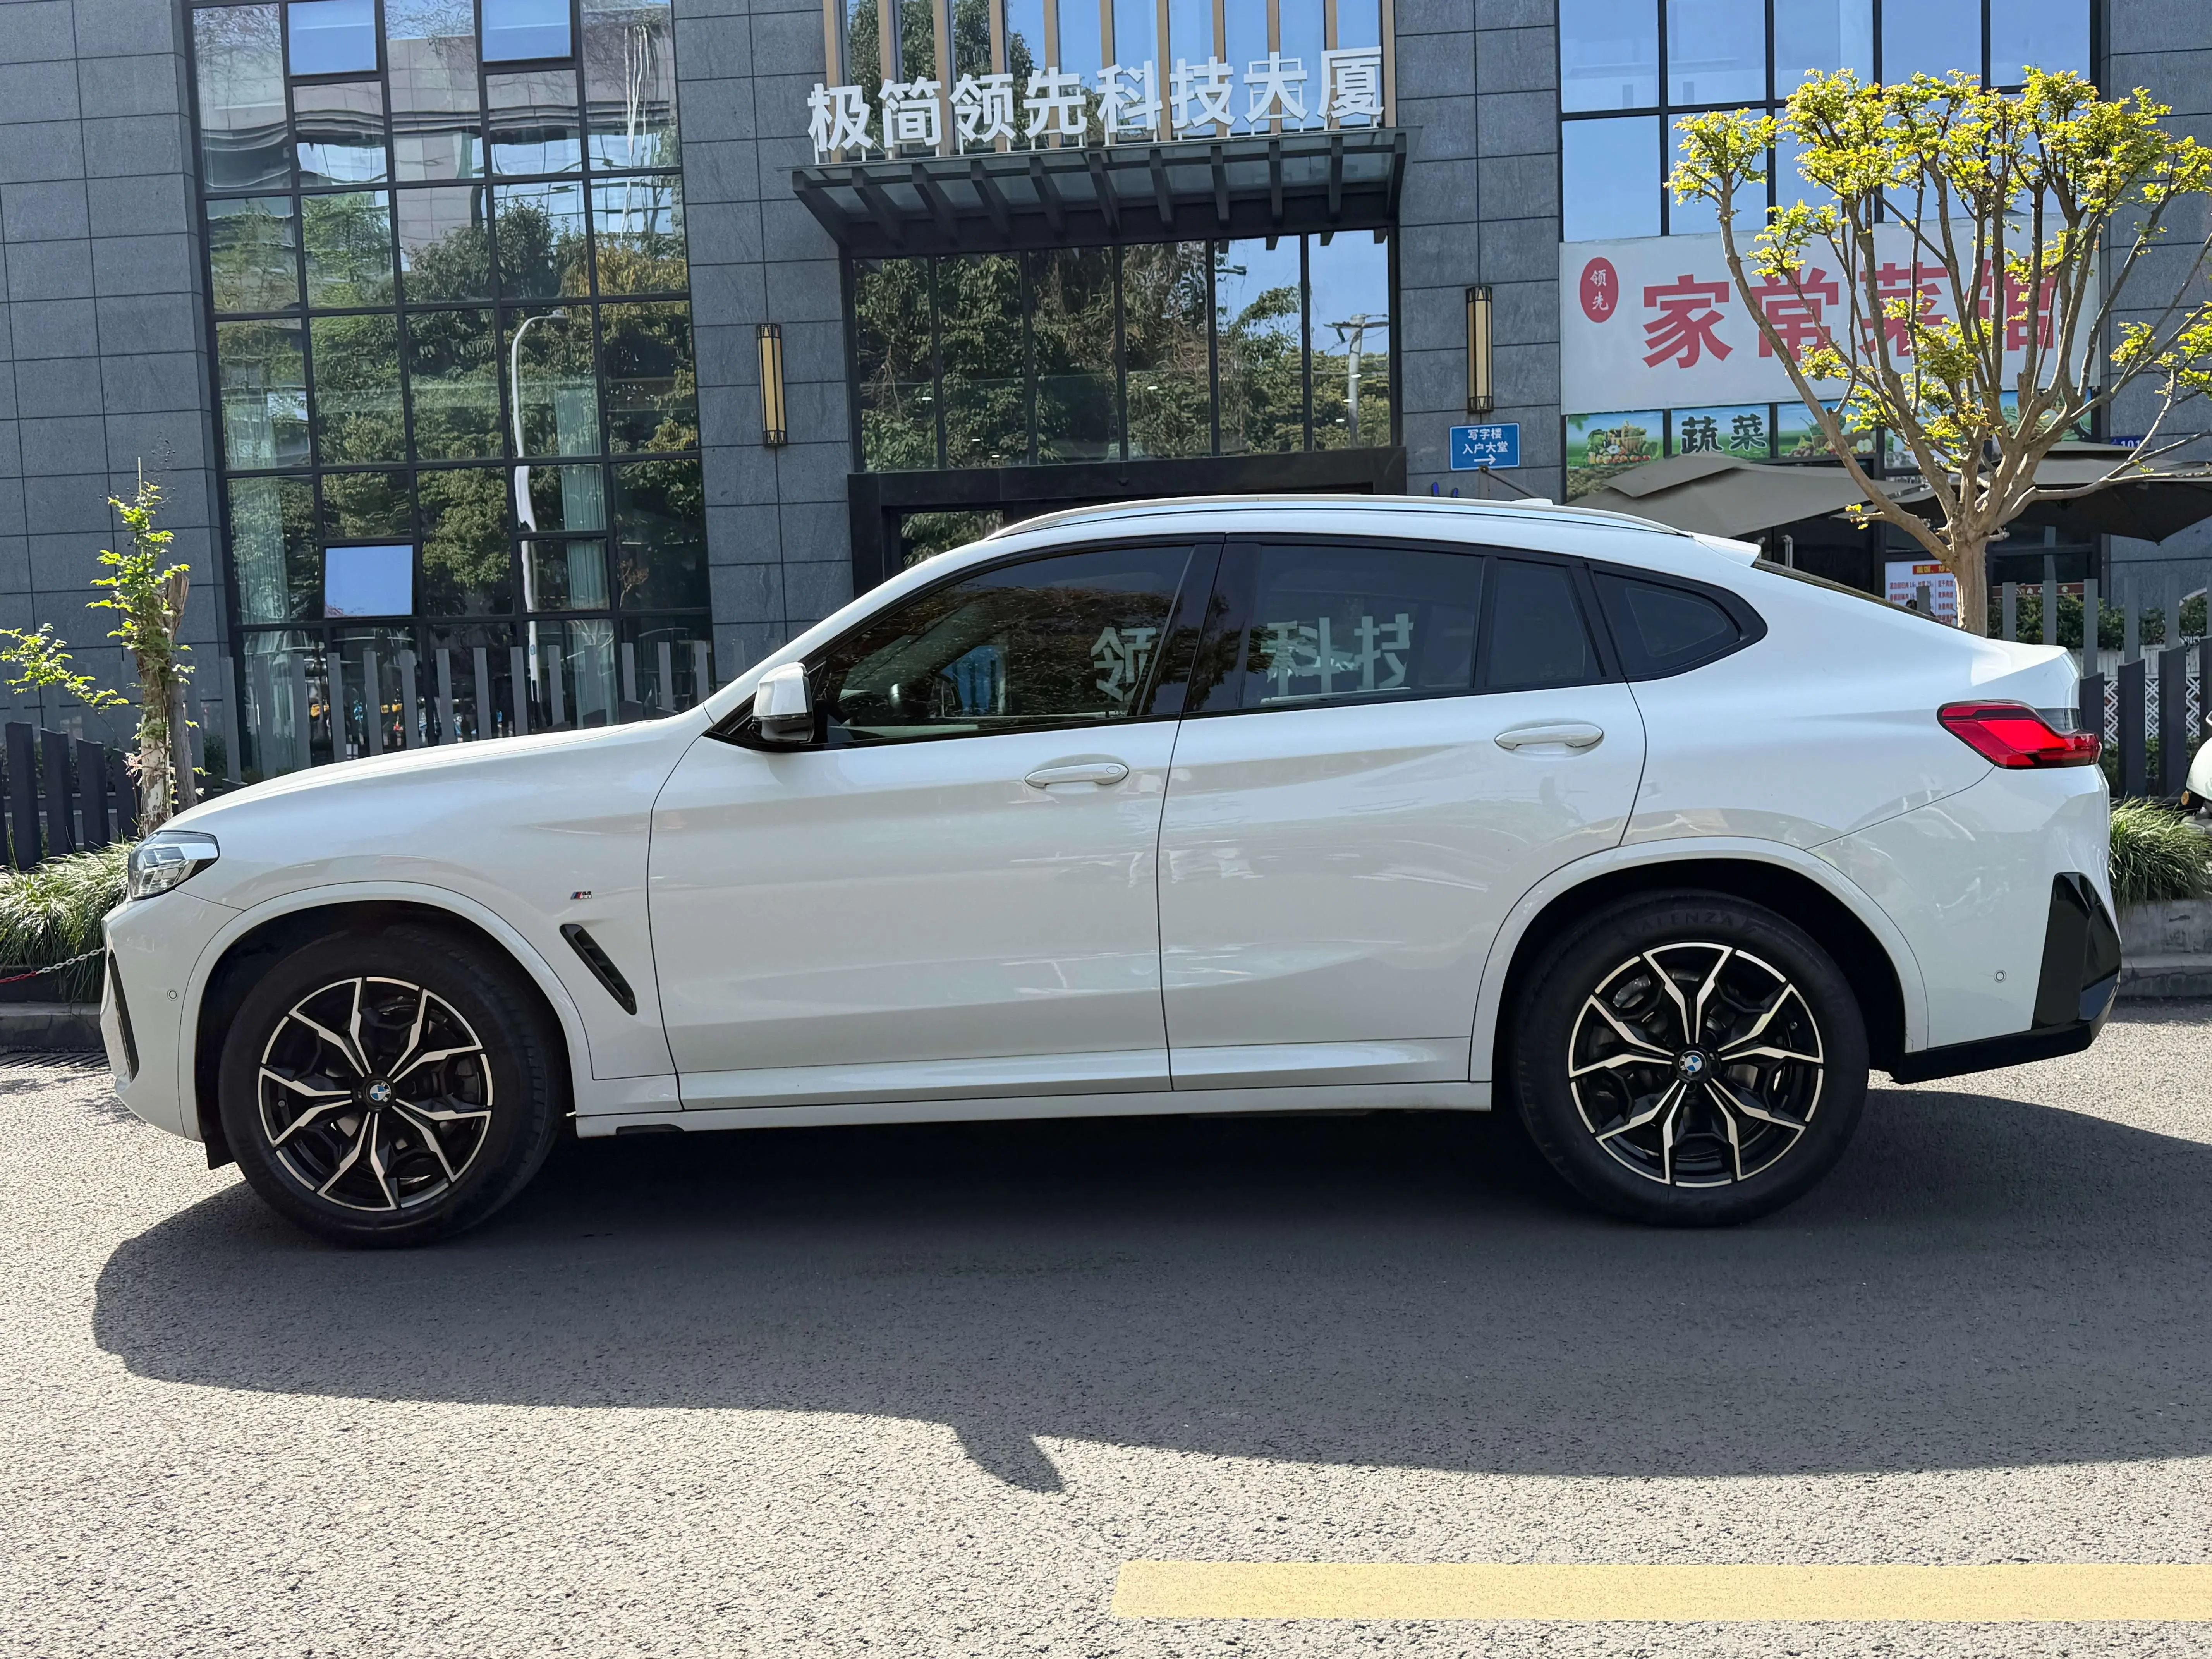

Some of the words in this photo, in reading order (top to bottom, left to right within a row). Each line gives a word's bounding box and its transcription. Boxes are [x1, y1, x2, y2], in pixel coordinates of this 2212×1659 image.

[808, 46, 1384, 151] 极简领先科技大厦
[1589, 269, 1609, 311] 领先
[1642, 256, 2057, 369] 家常菜馆
[1462, 441, 1508, 455] 入户大堂
[1468, 428, 1502, 440] 写字楼
[1681, 412, 1767, 455] 蔬菜
